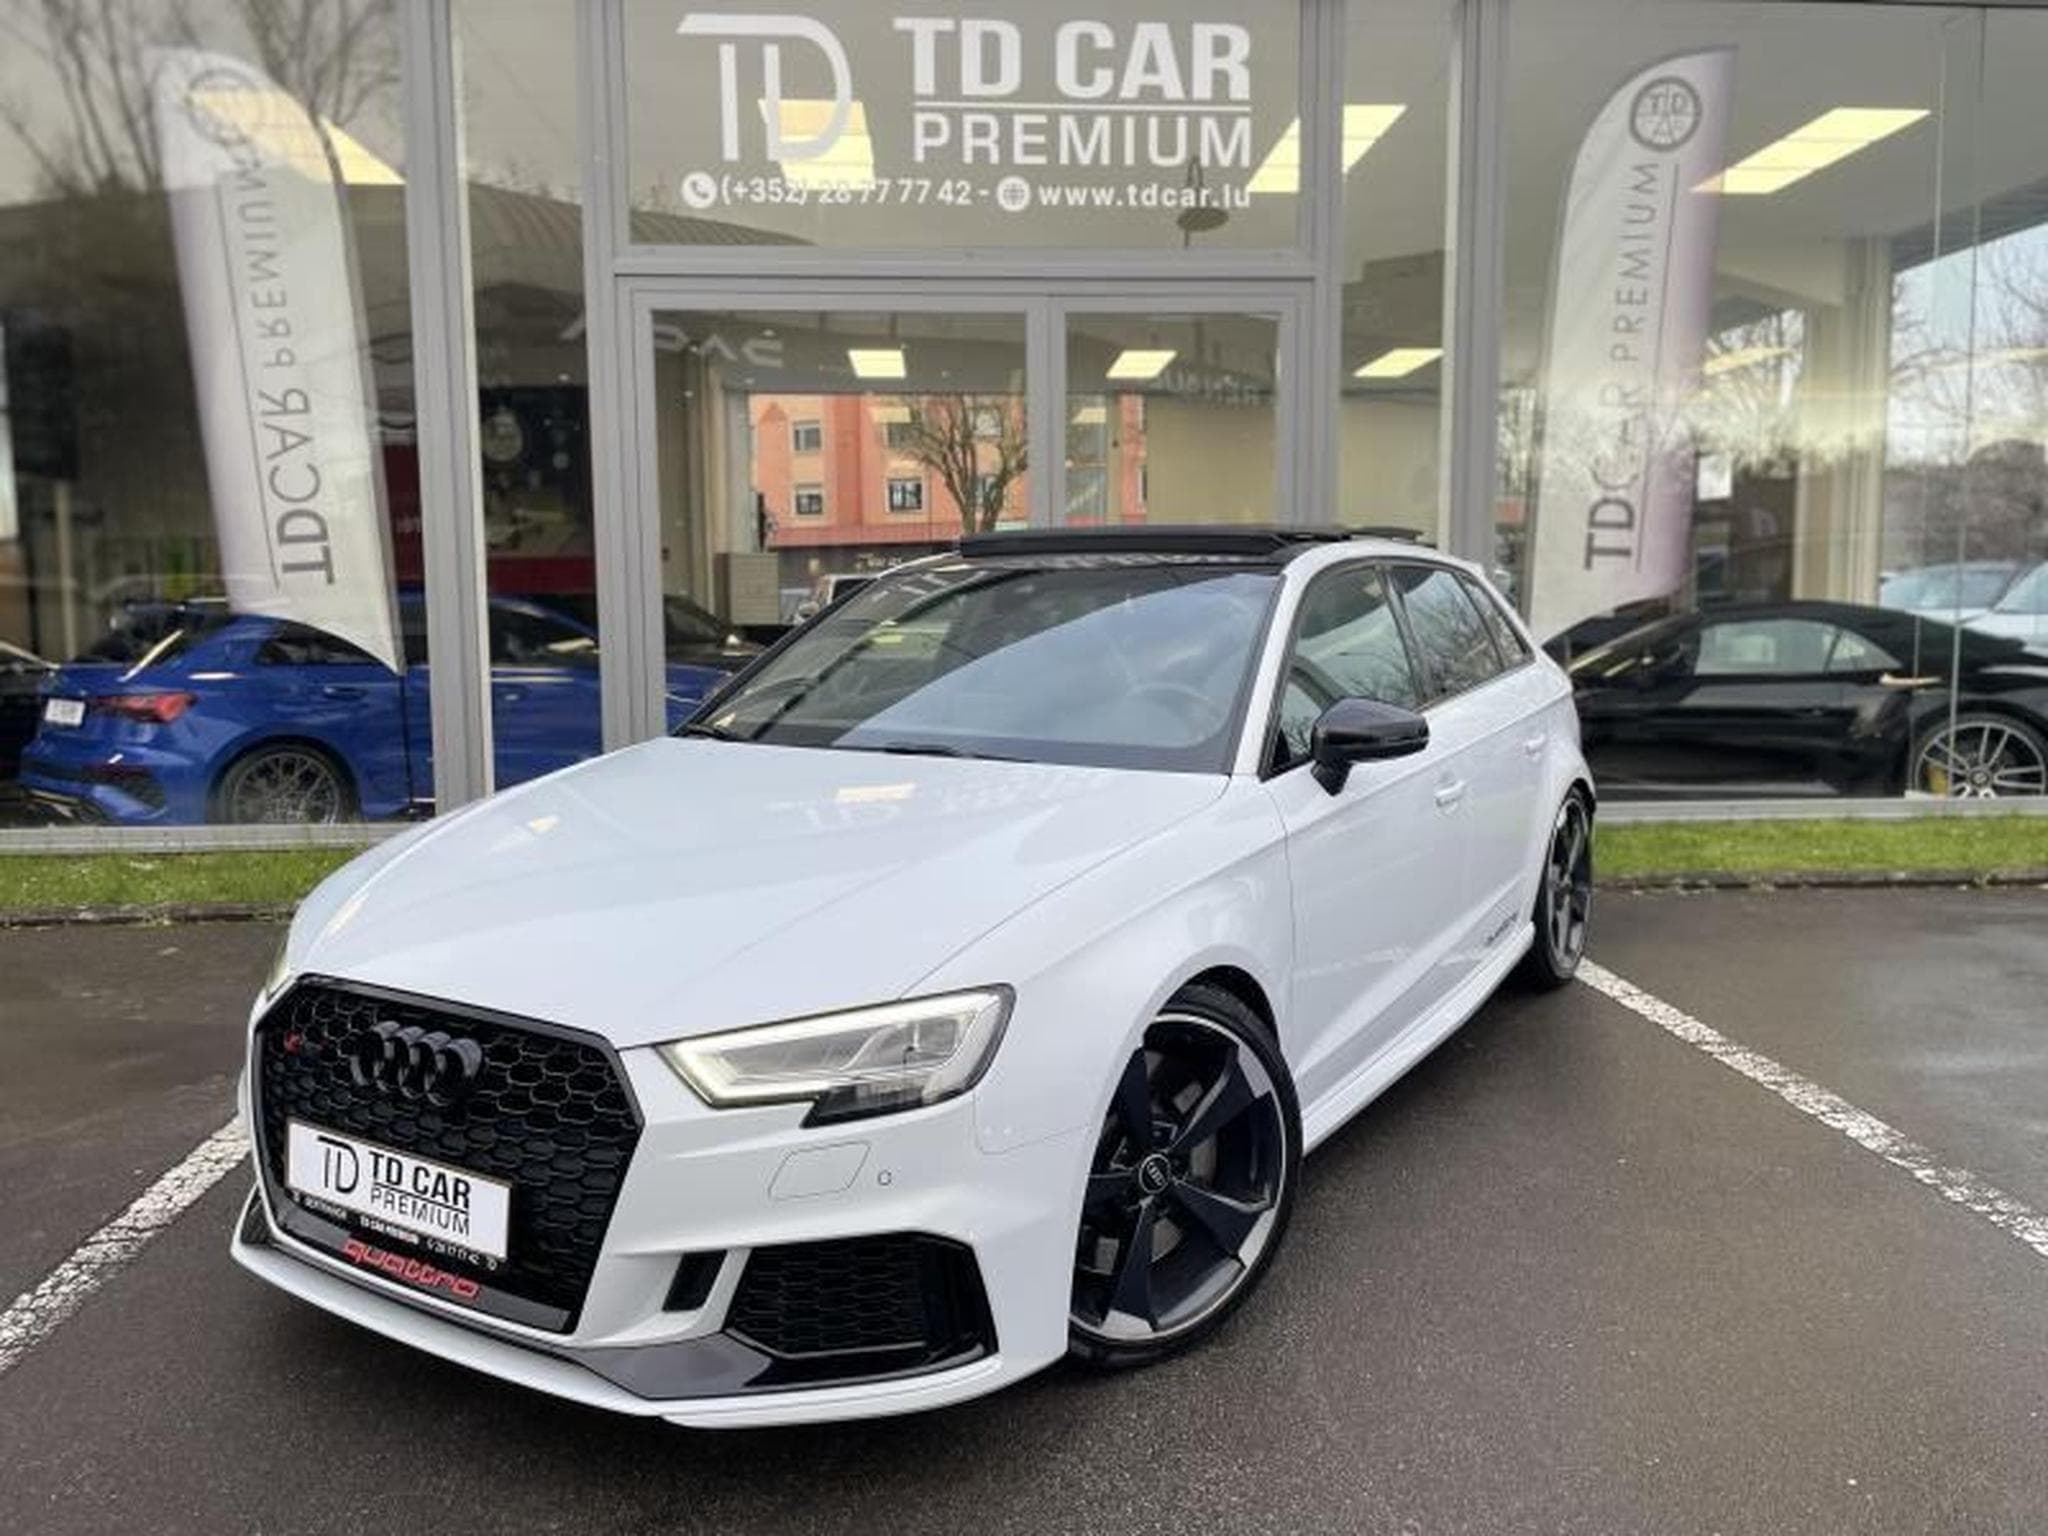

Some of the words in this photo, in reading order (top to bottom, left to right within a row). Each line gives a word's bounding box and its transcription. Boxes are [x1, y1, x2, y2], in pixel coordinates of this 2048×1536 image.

[893, 17, 1021, 97] TD
[1056, 20, 1251, 101] CAR
[914, 112, 1252, 168] PREMIUM
[721, 174, 808, 206] (+352)
[899, 179, 932, 203] 77
[937, 180, 973, 206] 42
[1038, 182, 1251, 208] www.tdcar.lu
[1609, 163, 1661, 362] PREMIUM
[368, 1151, 403, 1186] TD
[413, 1166, 471, 1211] CAR
[370, 1186, 470, 1237] PREMIUM
[342, 1239, 479, 1299] quattro
